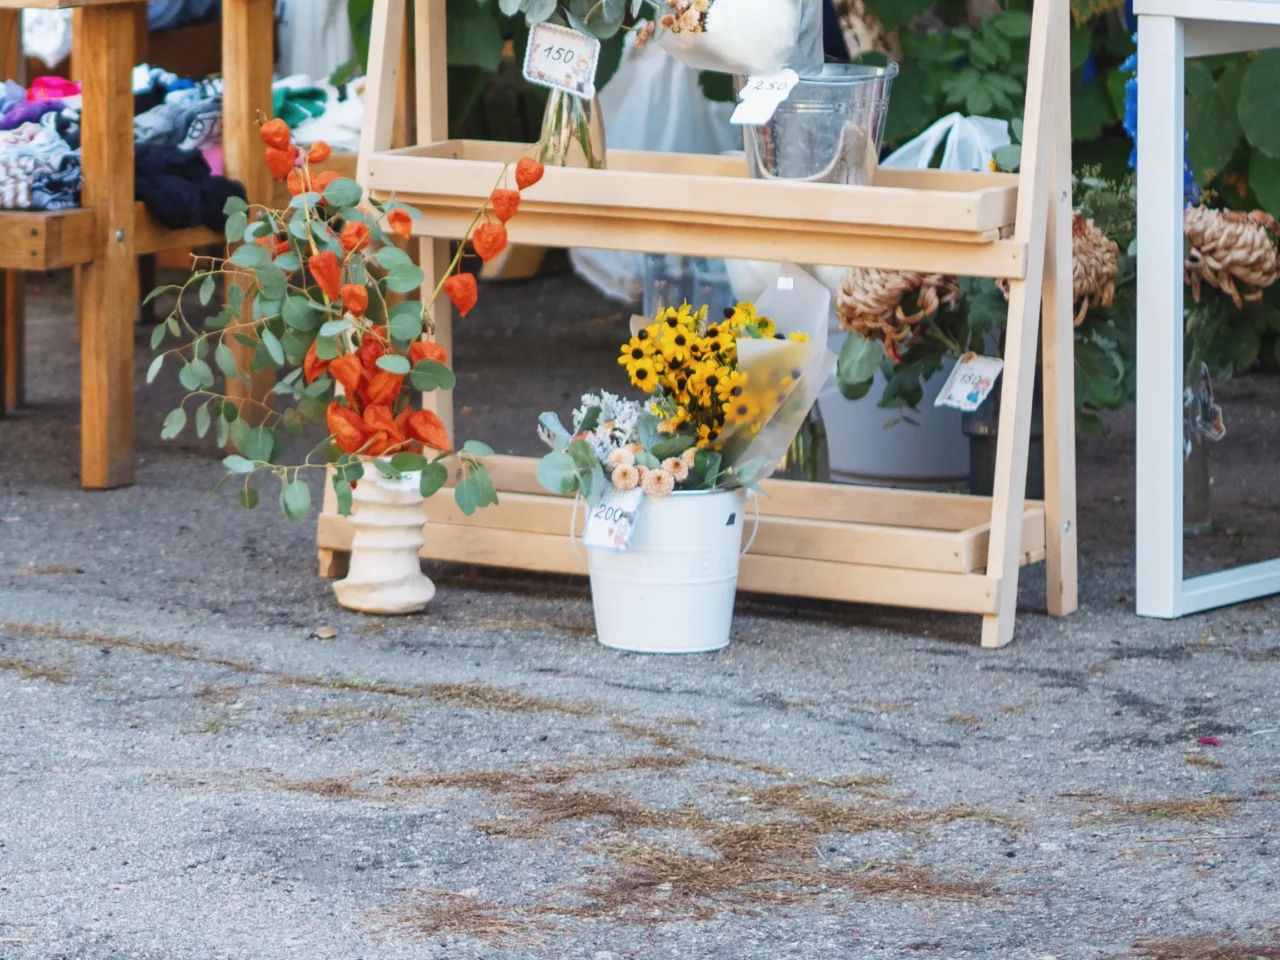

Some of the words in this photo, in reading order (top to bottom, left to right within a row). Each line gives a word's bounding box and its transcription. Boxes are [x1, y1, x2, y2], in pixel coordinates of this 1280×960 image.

[544, 45, 575, 63] 150
[753, 80, 788, 91] 250
[594, 503, 624, 522] 200
